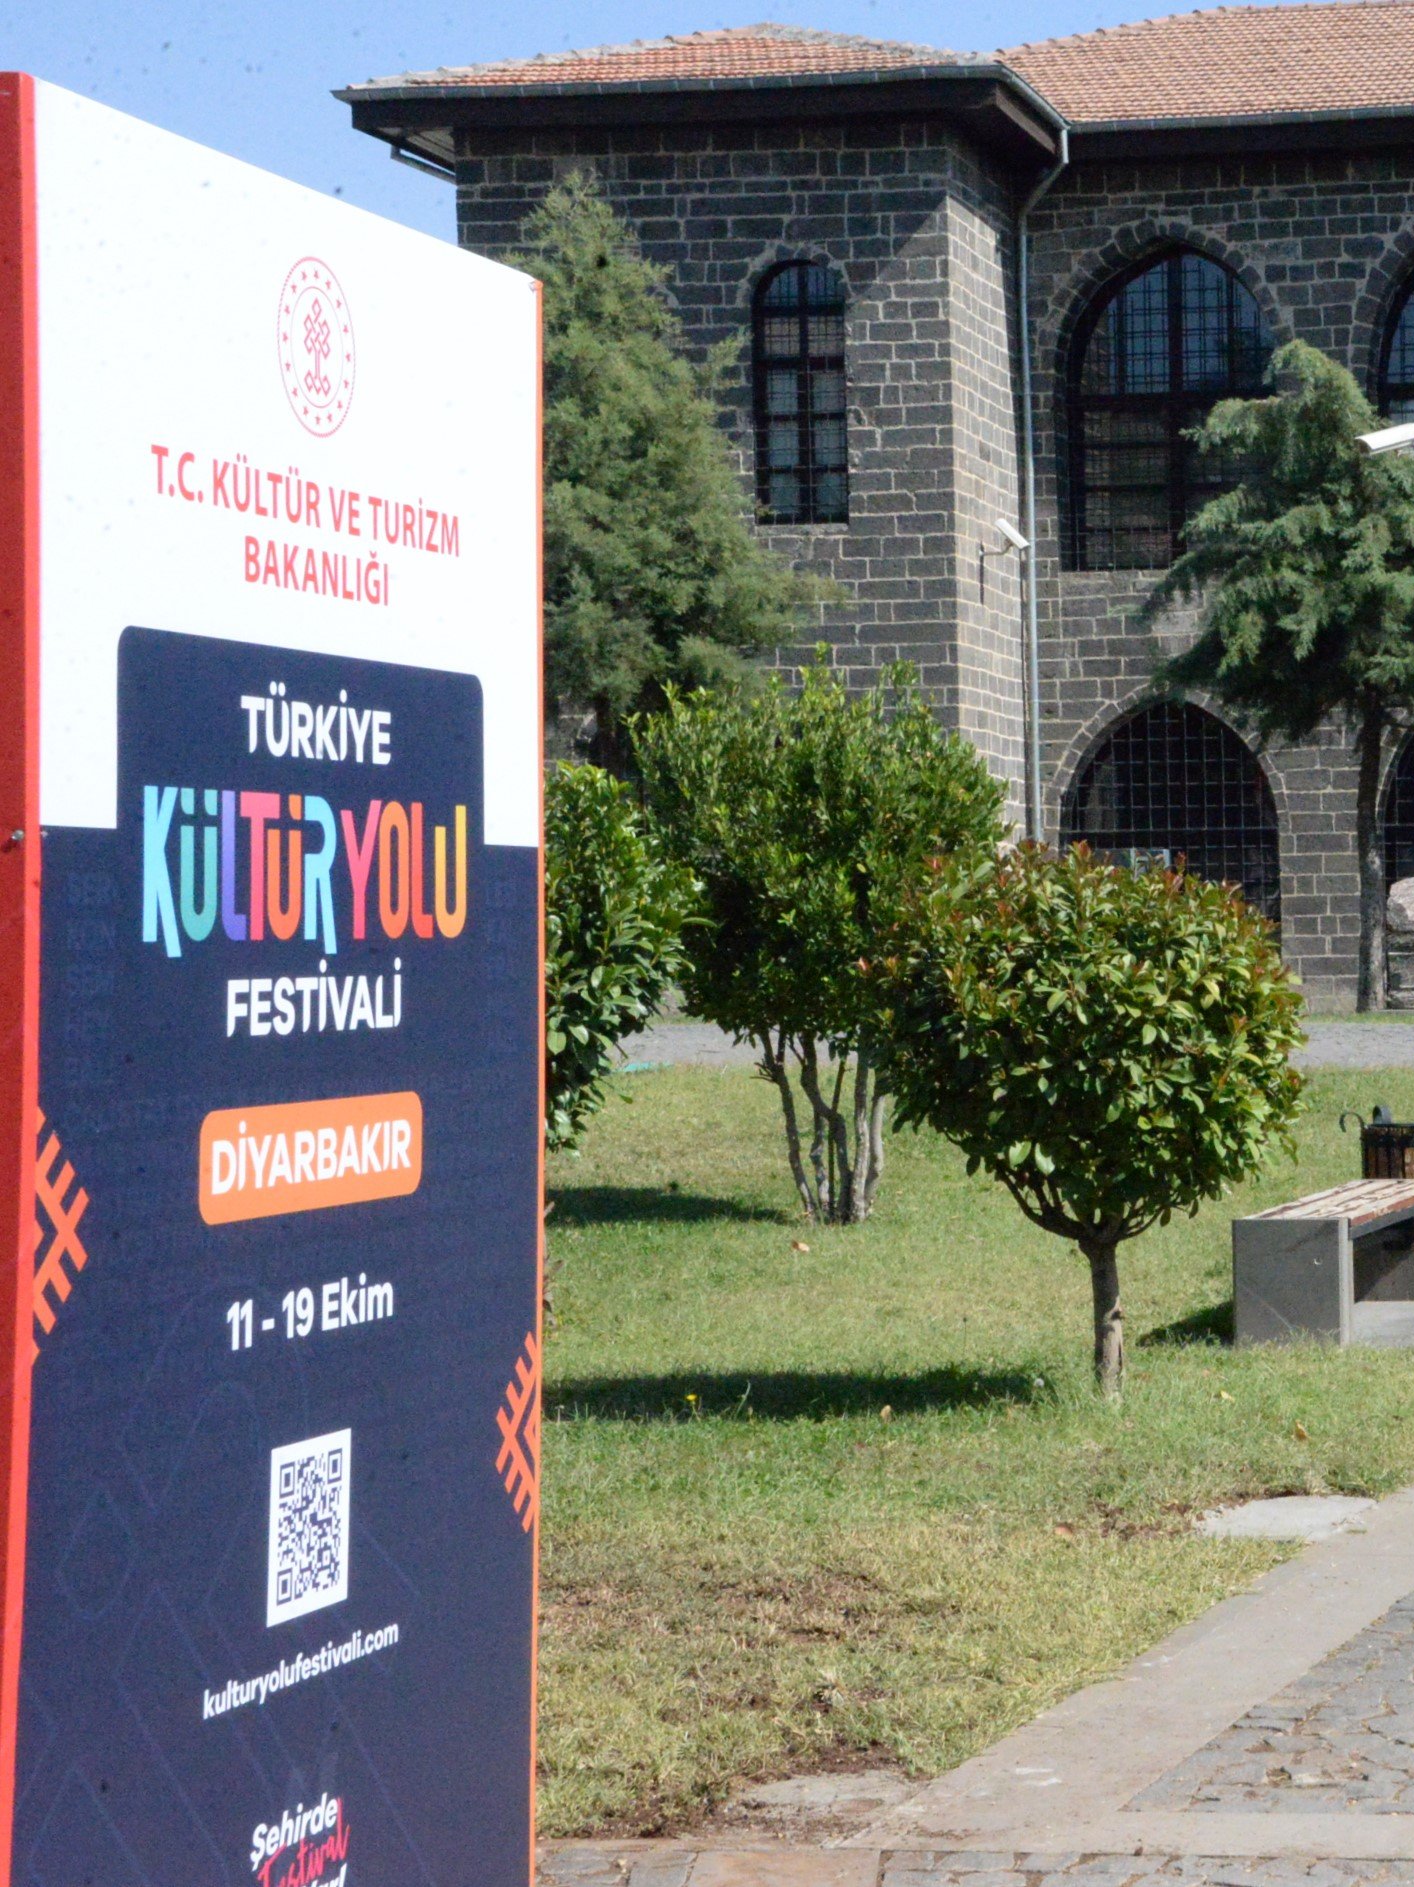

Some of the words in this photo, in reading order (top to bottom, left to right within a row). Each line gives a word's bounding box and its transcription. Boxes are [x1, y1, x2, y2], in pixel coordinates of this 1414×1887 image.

[150, 443, 204, 505] T.C.
[212, 452, 321, 529] KÜLTÜR
[328, 486, 361, 538] VE
[368, 497, 460, 558] TURİZM
[244, 535, 389, 607] BAKANLIĞI
[240, 681, 392, 765] TÜRKİYE
[142, 785, 337, 958] KÜLTÜR
[340, 799, 467, 941] YOLU
[226, 957, 402, 1038] FESTİVALİ
[210, 1119, 412, 1196] DİYARBAKIR
[226, 1299, 253, 1351] 11
[281, 1286, 314, 1338] 19
[322, 1272, 394, 1333] Ekim
[202, 1622, 399, 1721] kulturyolufestivali.com
[249, 1791, 338, 1872] Şehirde
